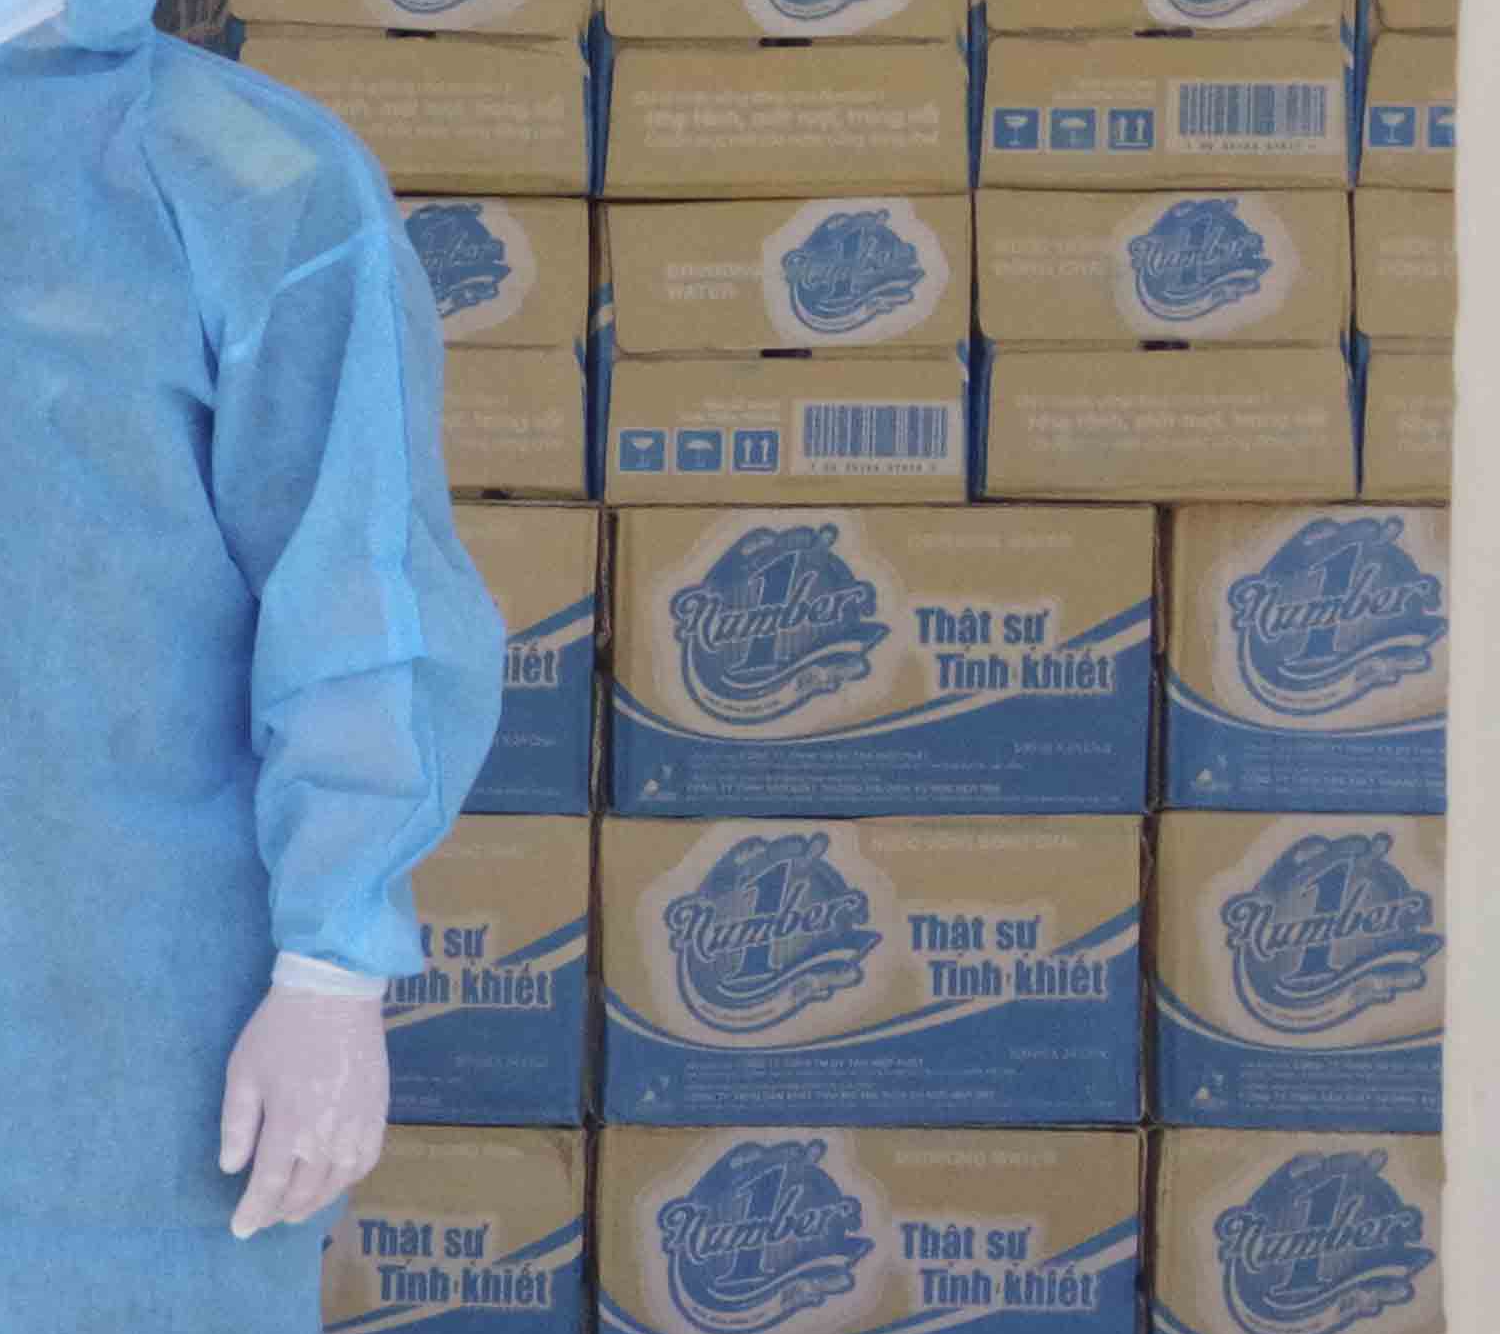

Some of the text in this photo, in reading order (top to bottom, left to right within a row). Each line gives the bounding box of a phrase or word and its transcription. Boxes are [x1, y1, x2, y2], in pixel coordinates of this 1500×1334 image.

[673, 572, 875, 651] Number
[915, 607, 1052, 652] Thật sự
[1229, 563, 1440, 644] Number
[504, 644, 557, 685] iết
[666, 878, 867, 961] Number
[907, 913, 1042, 957] Thật sự
[1222, 878, 1430, 962] Number
[358, 1218, 490, 1264] Thật sự
[659, 1184, 861, 1263] Number
[900, 1221, 1034, 1267] Thật sự
[1215, 1194, 1422, 1274] Number
